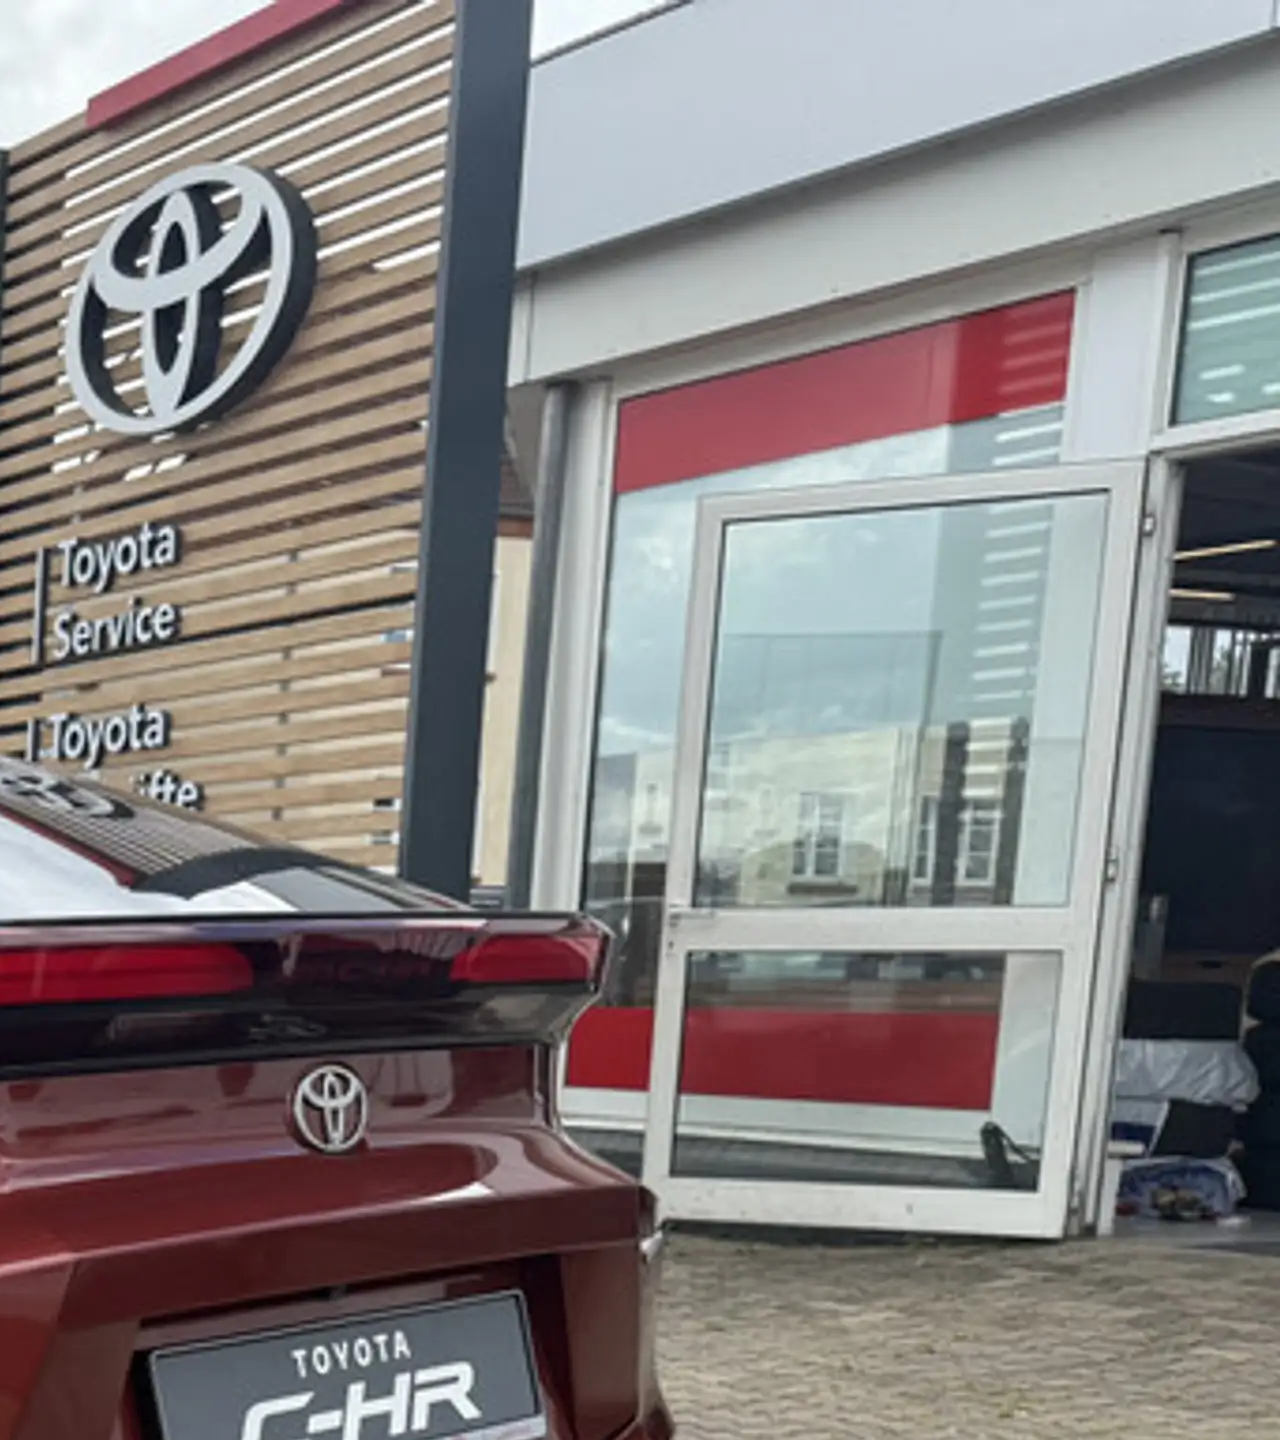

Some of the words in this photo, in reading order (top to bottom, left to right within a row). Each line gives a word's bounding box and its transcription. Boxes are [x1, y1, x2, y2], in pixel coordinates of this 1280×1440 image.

[58, 521, 177, 594] Toyota
[53, 597, 176, 659] Service
[49, 703, 165, 769] Toyota
[292, 1329, 412, 1378] TOYOTA
